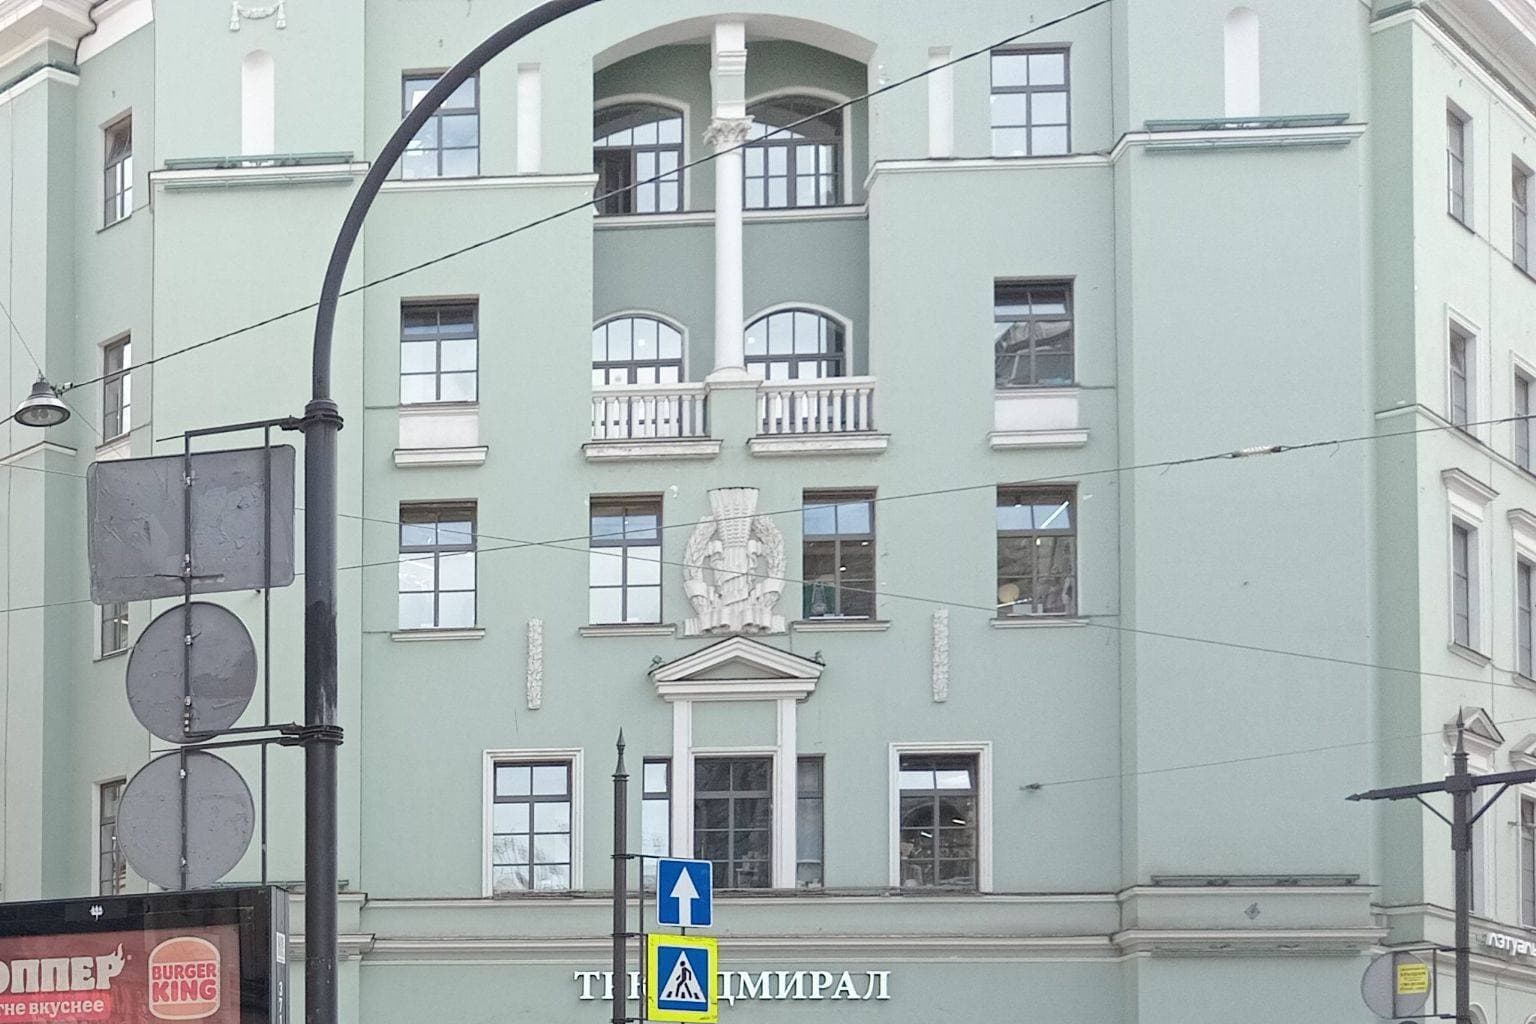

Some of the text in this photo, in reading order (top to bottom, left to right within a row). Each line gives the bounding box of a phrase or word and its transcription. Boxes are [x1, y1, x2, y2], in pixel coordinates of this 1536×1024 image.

[151, 962, 217, 980] BURGER
[151, 978, 217, 1002] KING
[717, 970, 891, 1008] ДМИРАЛ
[29, 999, 105, 1018] вкуснее
